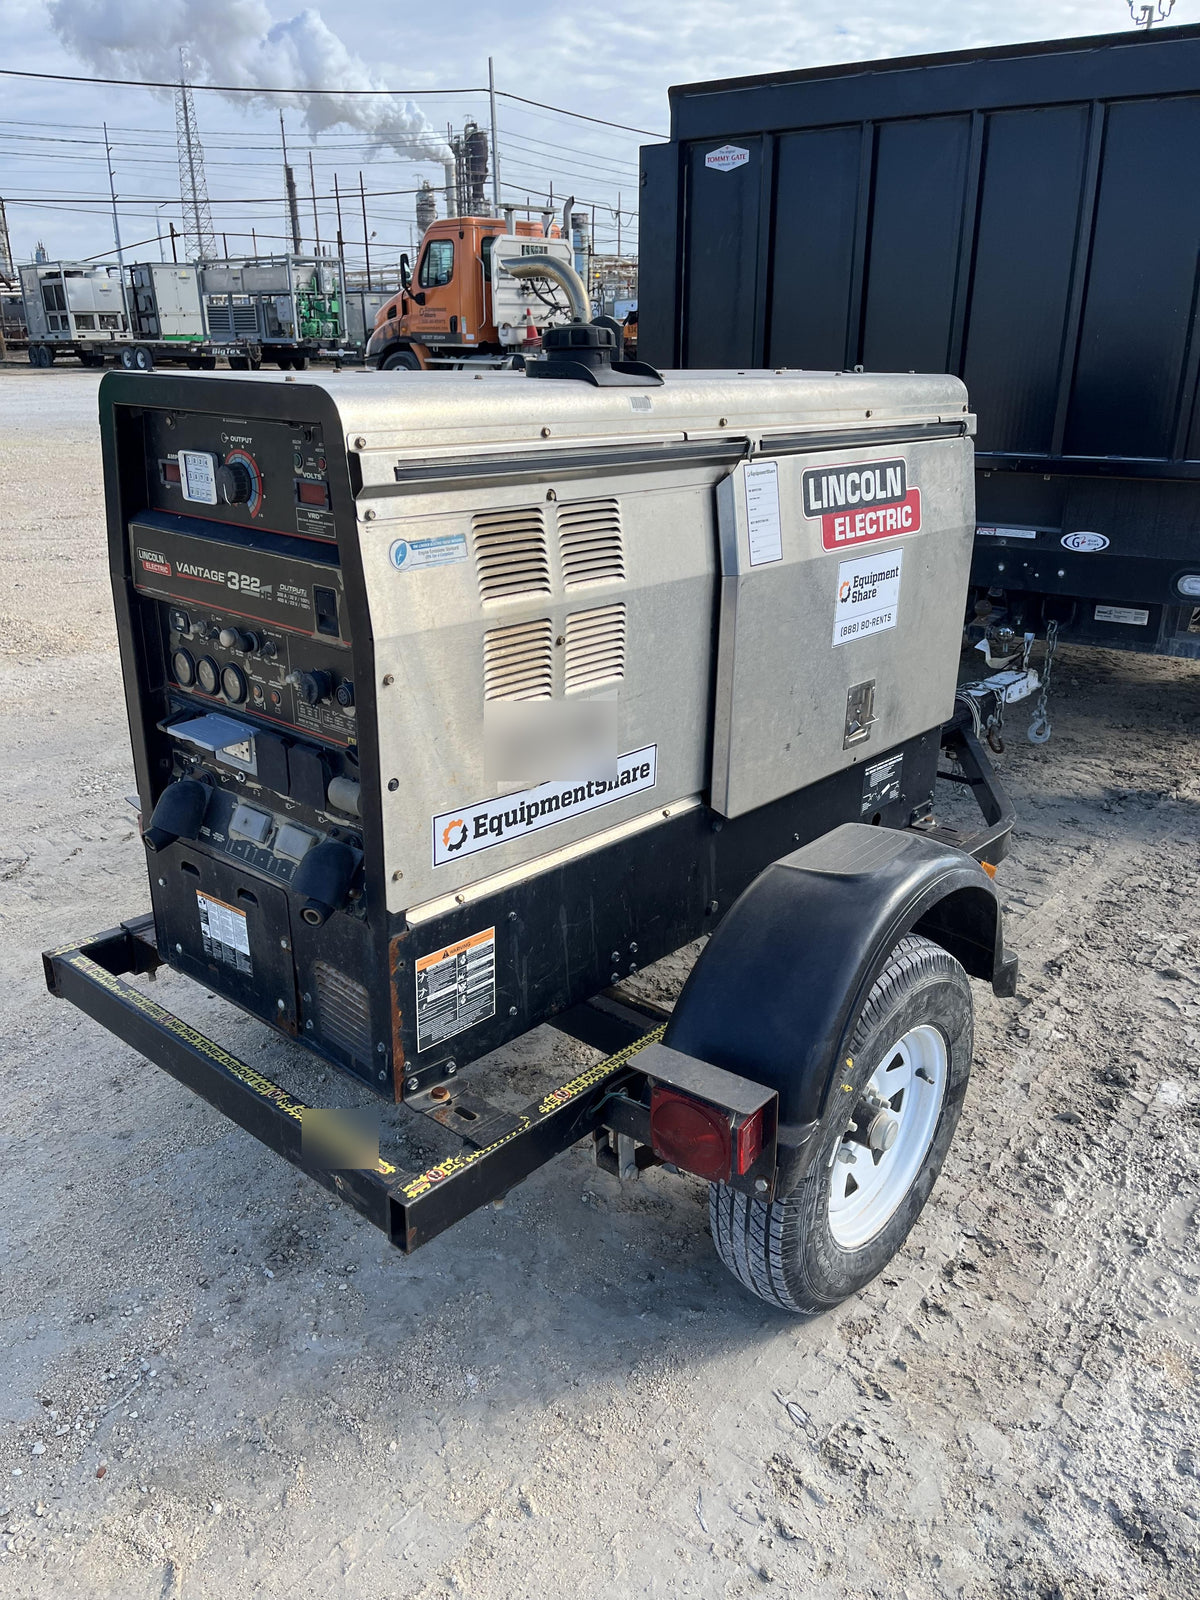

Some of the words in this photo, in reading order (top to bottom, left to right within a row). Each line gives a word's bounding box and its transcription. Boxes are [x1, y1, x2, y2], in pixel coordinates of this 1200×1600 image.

[707, 155, 729, 163] TOMMY
[230, 435, 252, 444] OUTPUT
[302, 472, 322, 480] VOLTS
[808, 466, 902, 510] LINCOLN
[834, 505, 912, 541] ELECTRIC
[139, 550, 164, 563] LINCOLN
[146, 562, 168, 573] ELECTRIC
[176, 562, 225, 582] VANTAGE
[228, 571, 260, 592] 322
[853, 566, 899, 589] Equipment
[852, 588, 877, 603] Share
[840, 622, 859, 637] (888)
[861, 613, 892, 630] 80-RENTS
[450, 942, 471, 954] WARNING
[141, 1002, 164, 1017] HERE
[170, 1020, 184, 1031] NE
[181, 1026, 199, 1041] PAS
[196, 1039, 226, 1059] TENEZ
[221, 1056, 259, 1083] DEBOUT
[255, 1081, 271, 1092] ICI
[570, 1082, 584, 1092] NE
[583, 1069, 605, 1082] PAS
[605, 1049, 634, 1069] TENEZ
[634, 1030, 664, 1050] DEBO
